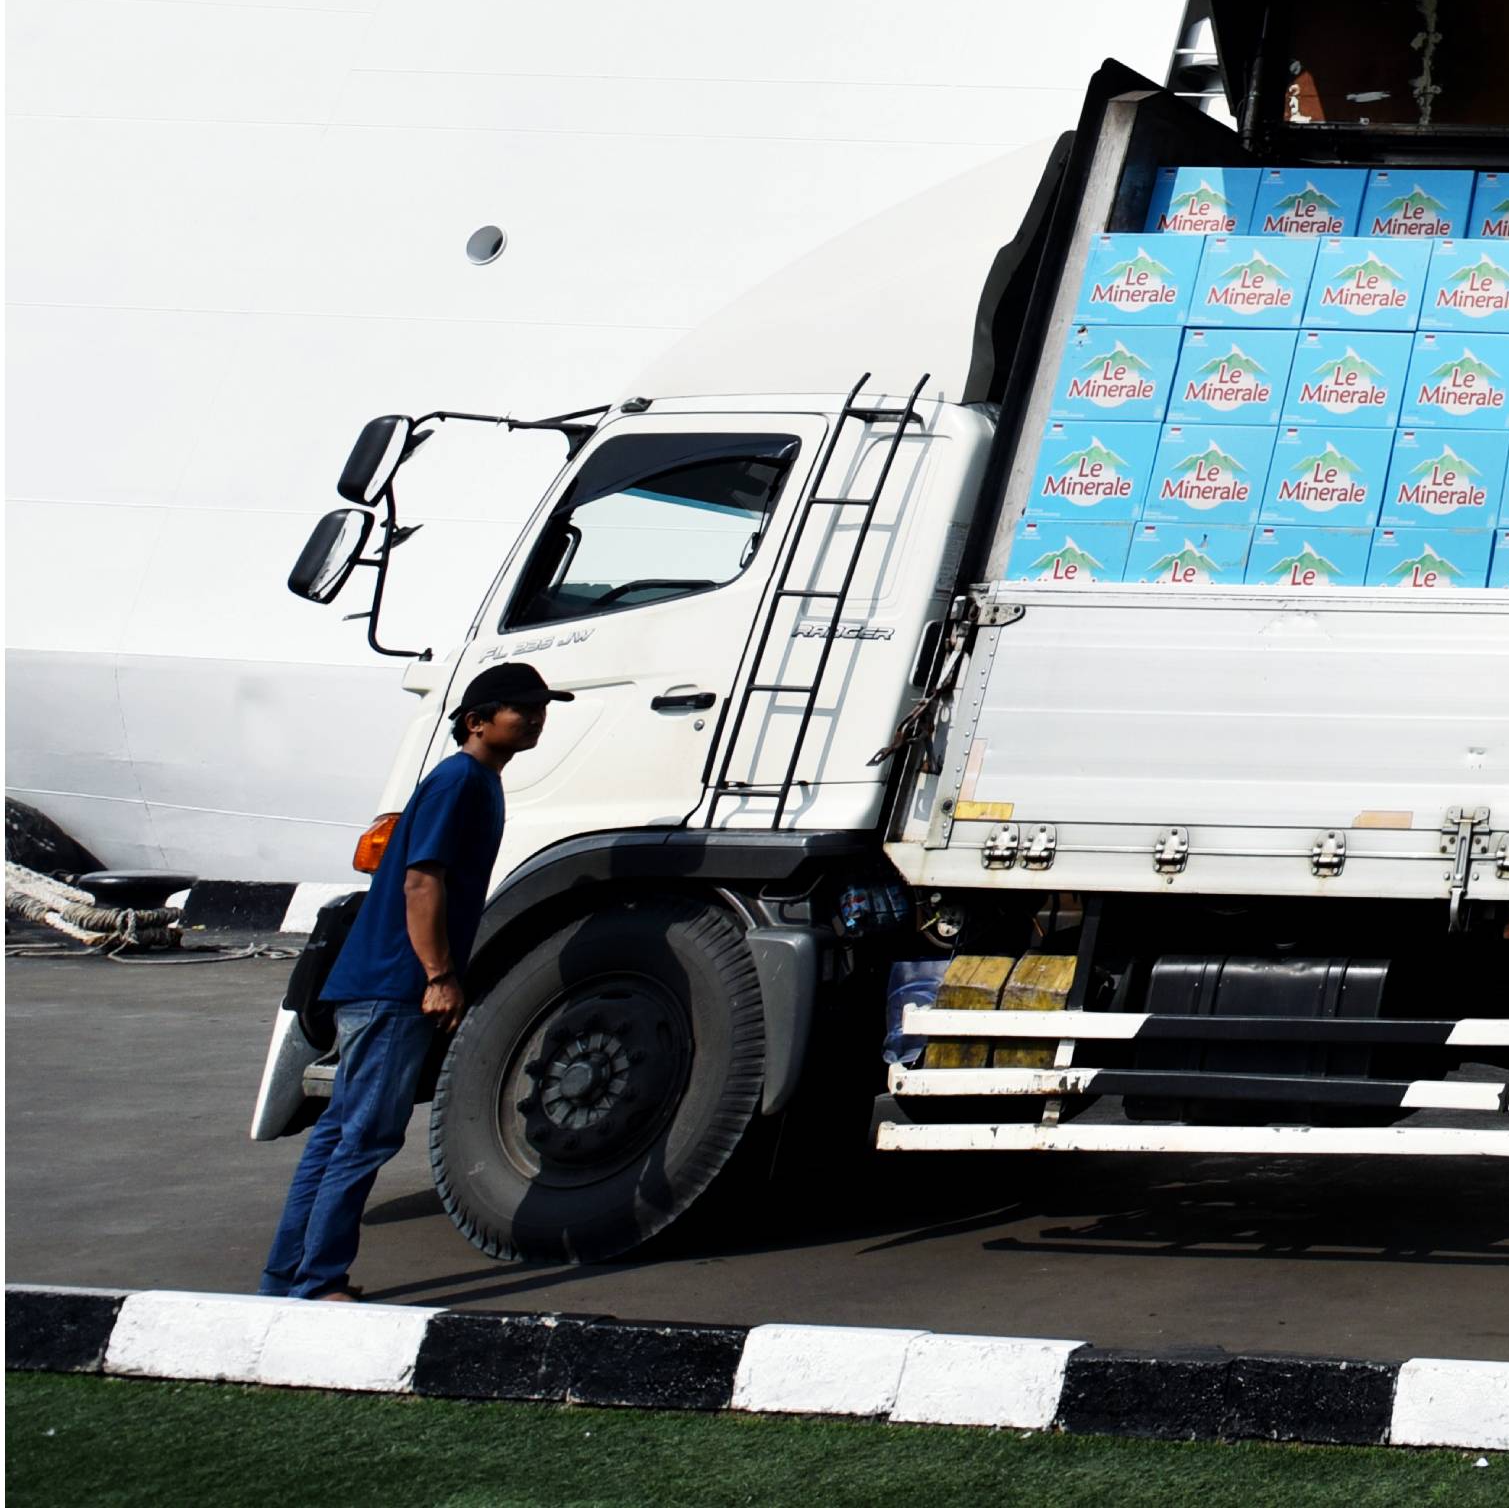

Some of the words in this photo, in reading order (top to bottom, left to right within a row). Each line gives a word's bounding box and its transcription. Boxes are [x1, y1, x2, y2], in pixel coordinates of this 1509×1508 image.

[1187, 198, 1211, 217] Le
[1402, 203, 1425, 223] Le
[1156, 213, 1236, 233] Minerale
[1373, 218, 1450, 237] Minerale
[1123, 268, 1149, 289] Le
[1237, 271, 1265, 292] Le
[1468, 273, 1494, 294] Le
[1093, 284, 1175, 303] Minerale
[1210, 287, 1292, 306] Minerale
[1102, 361, 1127, 382] Le
[1217, 364, 1244, 387] Le
[1331, 367, 1358, 388] Le
[1450, 368, 1477, 391] Le
[1069, 379, 1153, 398] Minerale
[1186, 382, 1269, 401] Minerale
[1301, 384, 1386, 404] Minerale
[1420, 386, 1504, 406] Minerale
[1078, 459, 1104, 478] Le
[1312, 463, 1338, 486] Le
[1430, 466, 1457, 490] Le
[1044, 476, 1131, 496] Minerale
[1279, 481, 1365, 502] Minerale
[1399, 485, 1486, 505] Minerale
[1170, 561, 1196, 584] Le
[1289, 565, 1316, 587] Le
